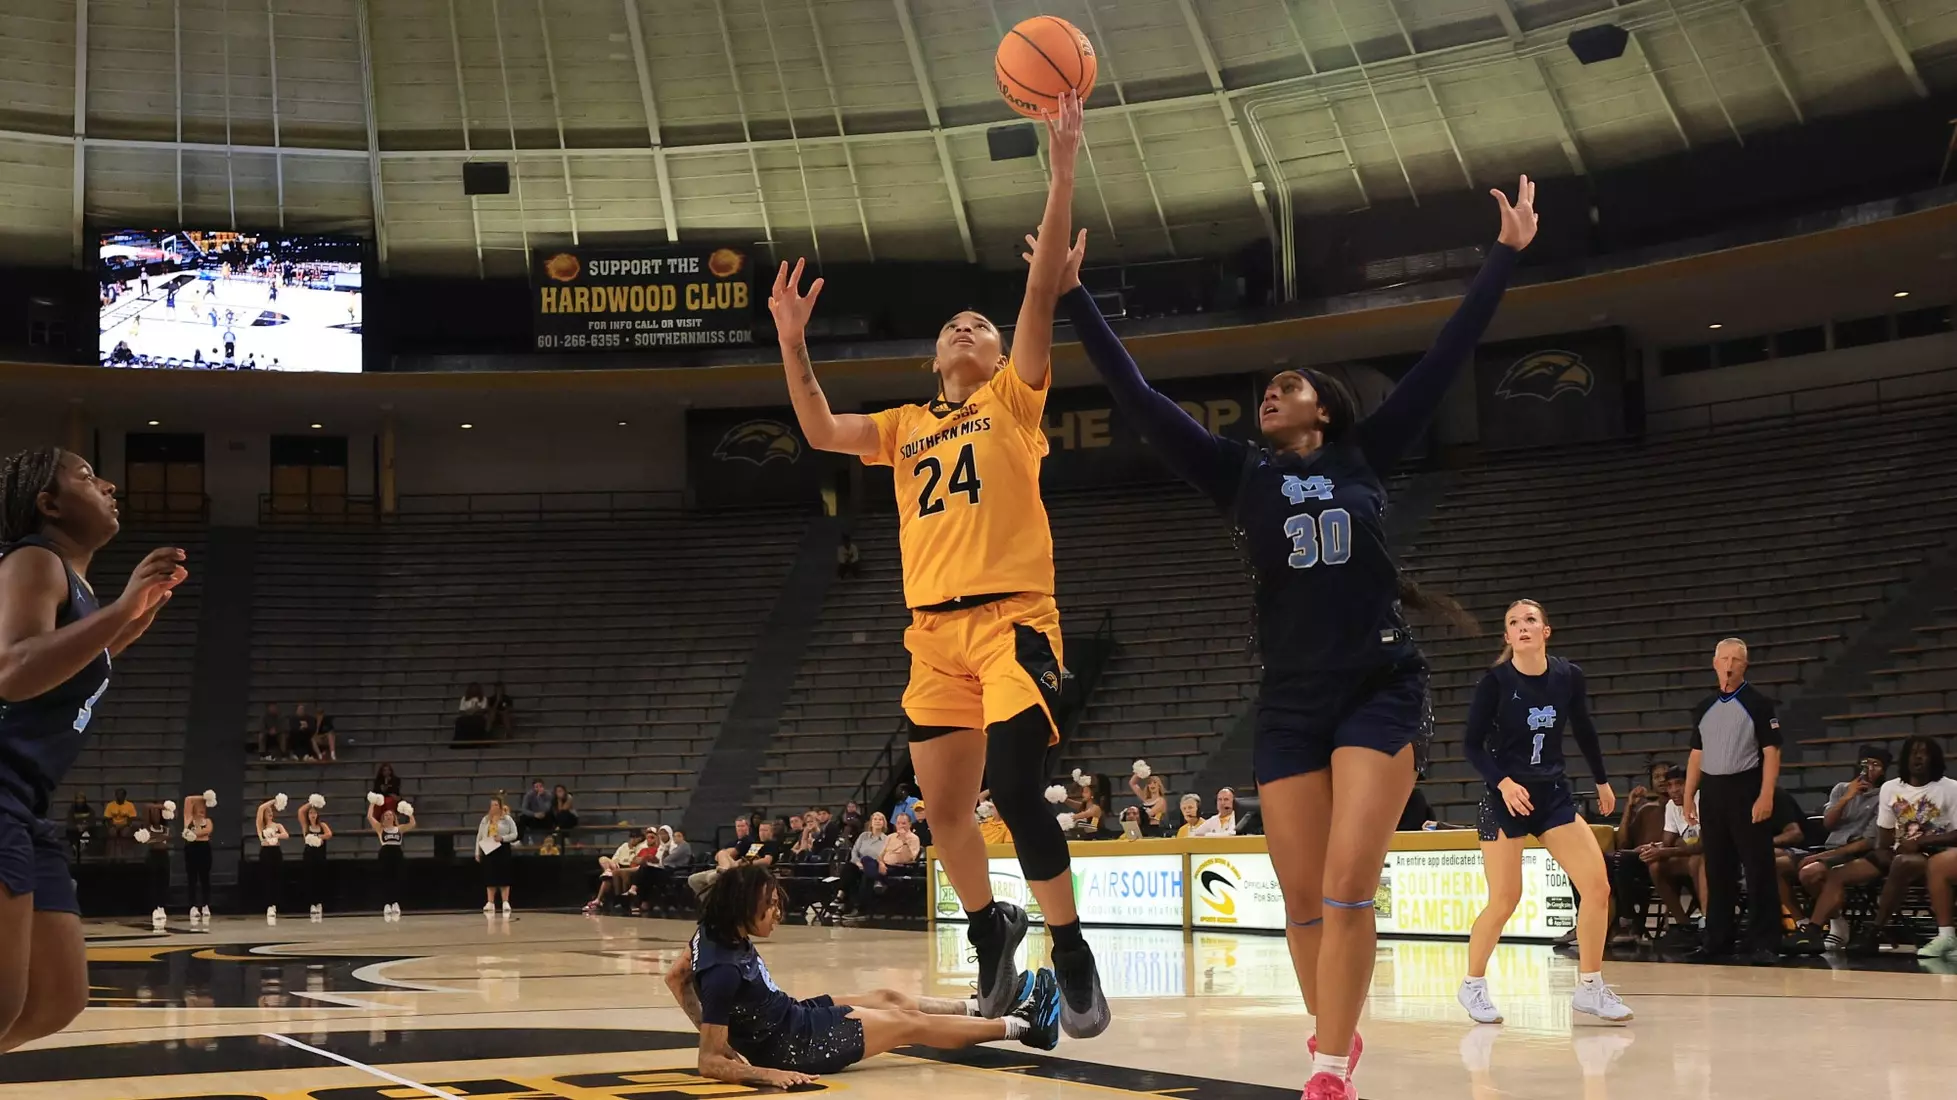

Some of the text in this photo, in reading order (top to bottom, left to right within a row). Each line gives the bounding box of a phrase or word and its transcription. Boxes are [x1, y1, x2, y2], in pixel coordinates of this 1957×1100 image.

[589, 257, 700, 276] SUPPORT THE
[541, 282, 749, 314] HARDWOOD CLUB
[588, 318, 703, 330] FOR INFO CALL OR VISIT
[537, 330, 753, 348] 601-266-6355 SOUTHERNMISS.COM
[960, 417, 991, 435] MISS
[1043, 408, 1113, 450] HE
[913, 442, 982, 518] 24
[1284, 508, 1351, 569] 30
[1530, 733, 1545, 765] 1
[1396, 855, 1405, 866] An
[1406, 855, 1426, 866] entire
[1428, 856, 1440, 868] app
[1441, 854, 1476, 866] dedicated
[1521, 855, 1537, 866] ame
[992, 880, 1017, 899] ARREL
[1088, 870, 1183, 898] AIRSOUTH
[1545, 873, 1572, 887] TODA
[1087, 905, 1122, 916] COOLING
[1128, 905, 1144, 916] AND
